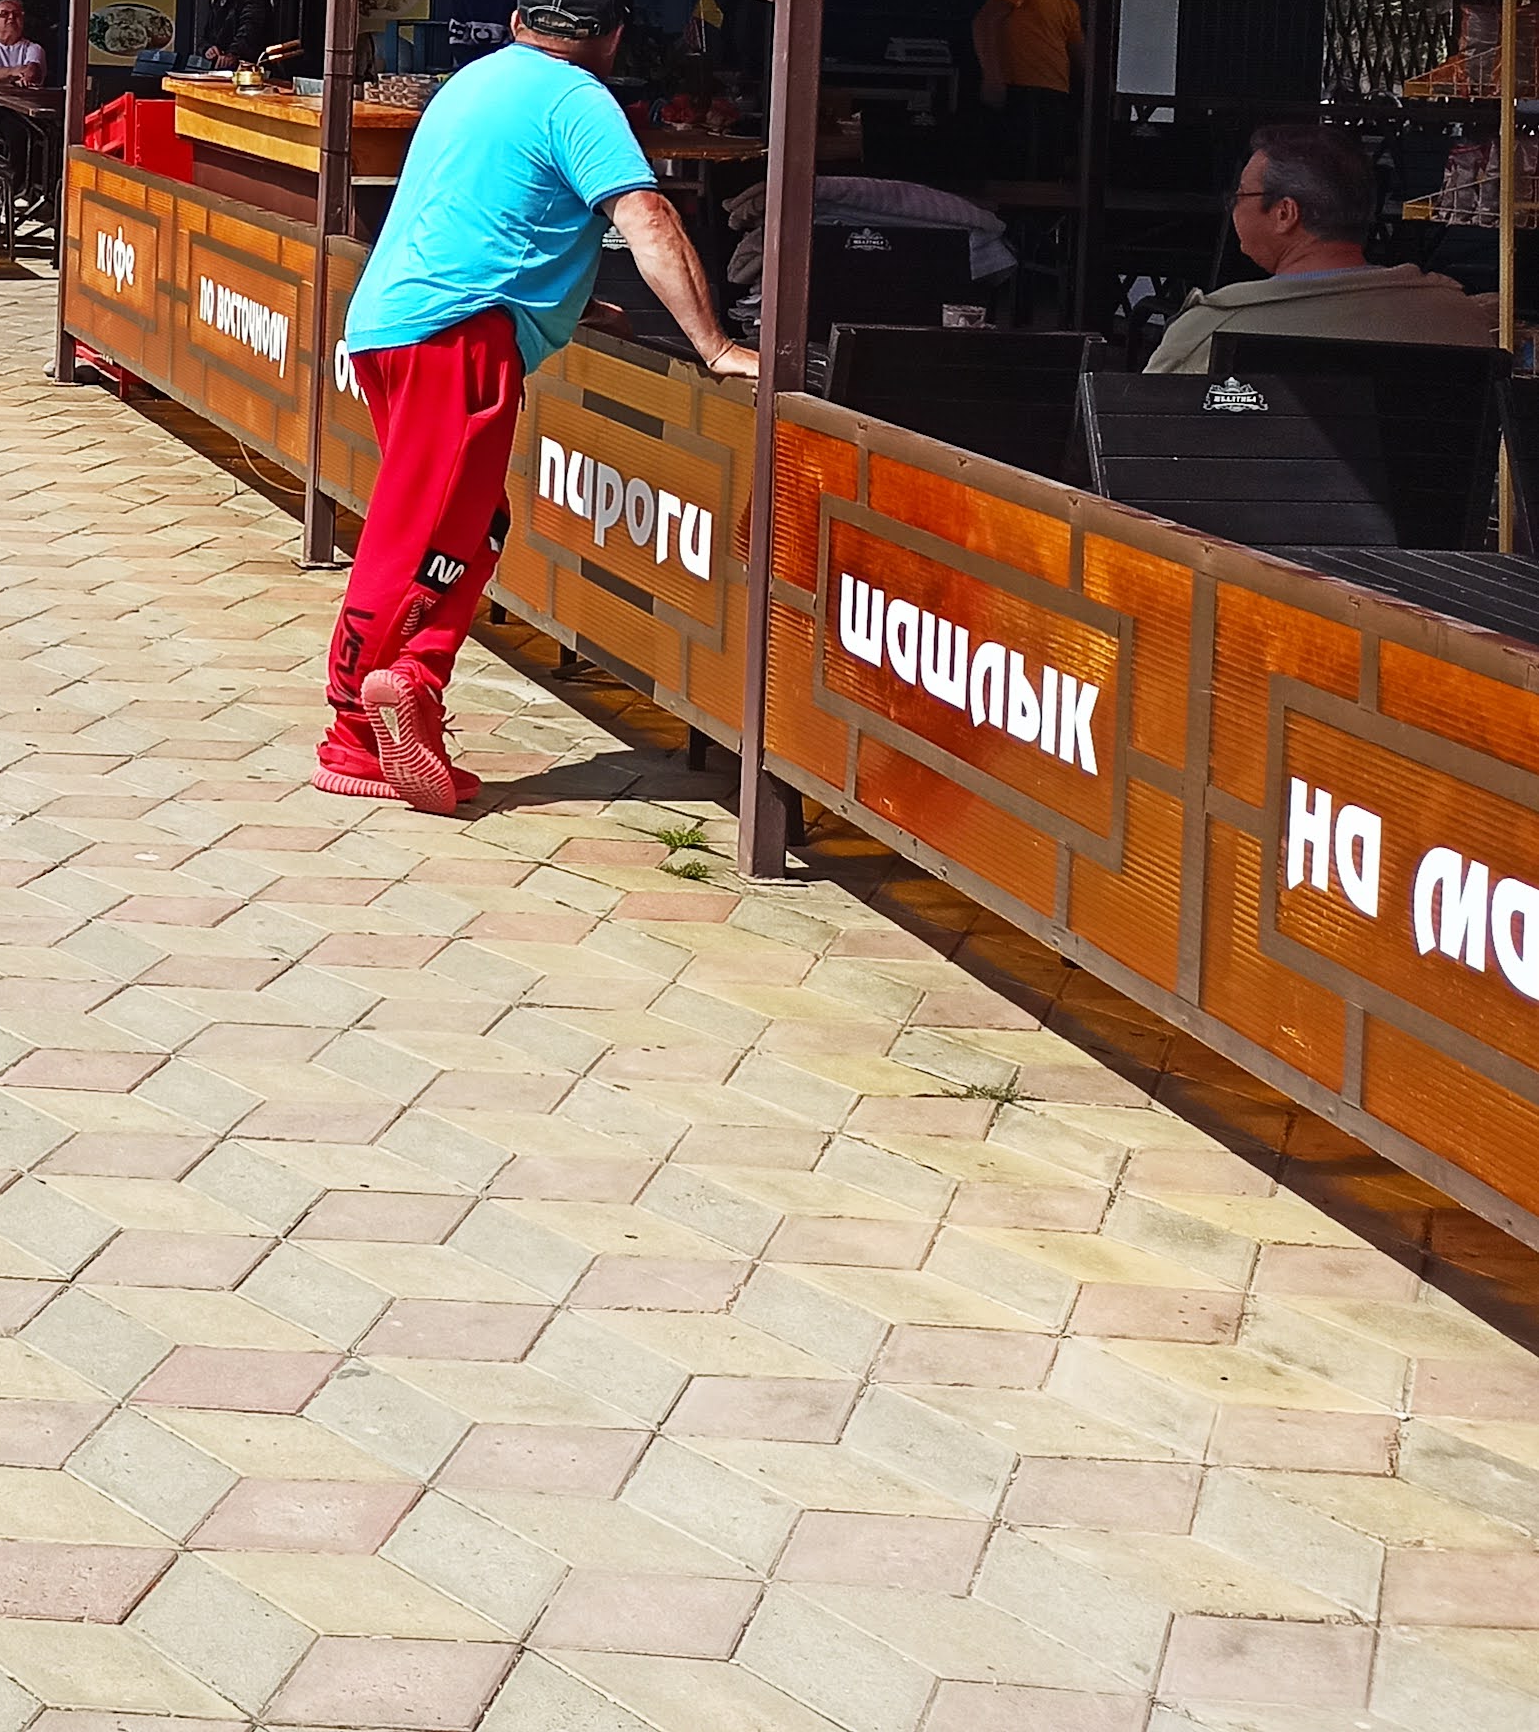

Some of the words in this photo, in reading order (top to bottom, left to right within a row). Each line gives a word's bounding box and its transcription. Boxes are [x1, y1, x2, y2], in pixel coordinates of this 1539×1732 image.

[96, 225, 135, 293] кофе
[198, 274, 215, 329] по
[215, 279, 290, 378] восточному
[537, 435, 713, 582] пироги
[837, 572, 1102, 777] шашлык
[1286, 776, 1383, 920] на
